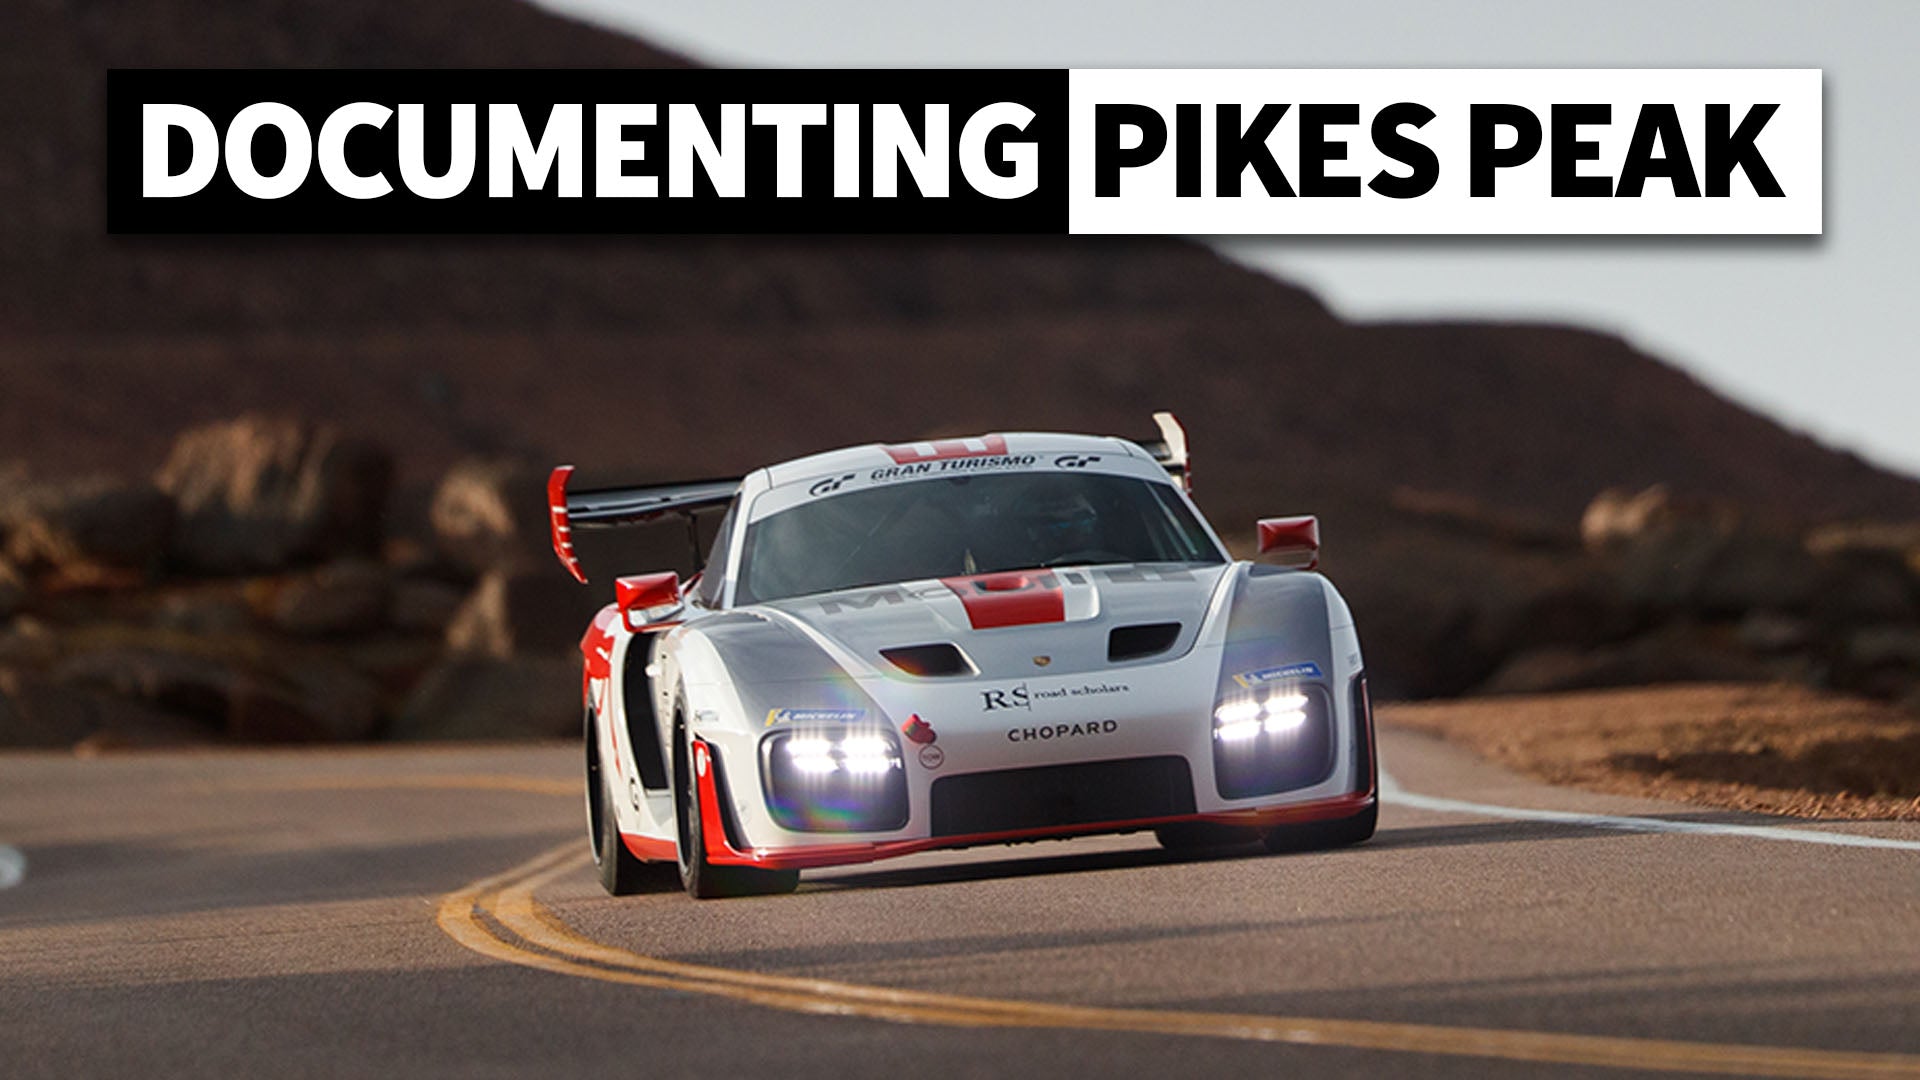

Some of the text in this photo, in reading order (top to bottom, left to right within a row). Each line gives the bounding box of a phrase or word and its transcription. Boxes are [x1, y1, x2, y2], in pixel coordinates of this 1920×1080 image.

[871, 463, 930, 480] GRAN
[940, 455, 1036, 472] TURISMO
[981, 684, 1031, 711] RS
[1034, 688, 1067, 699] road
[1008, 719, 1118, 742] CHOPARD
